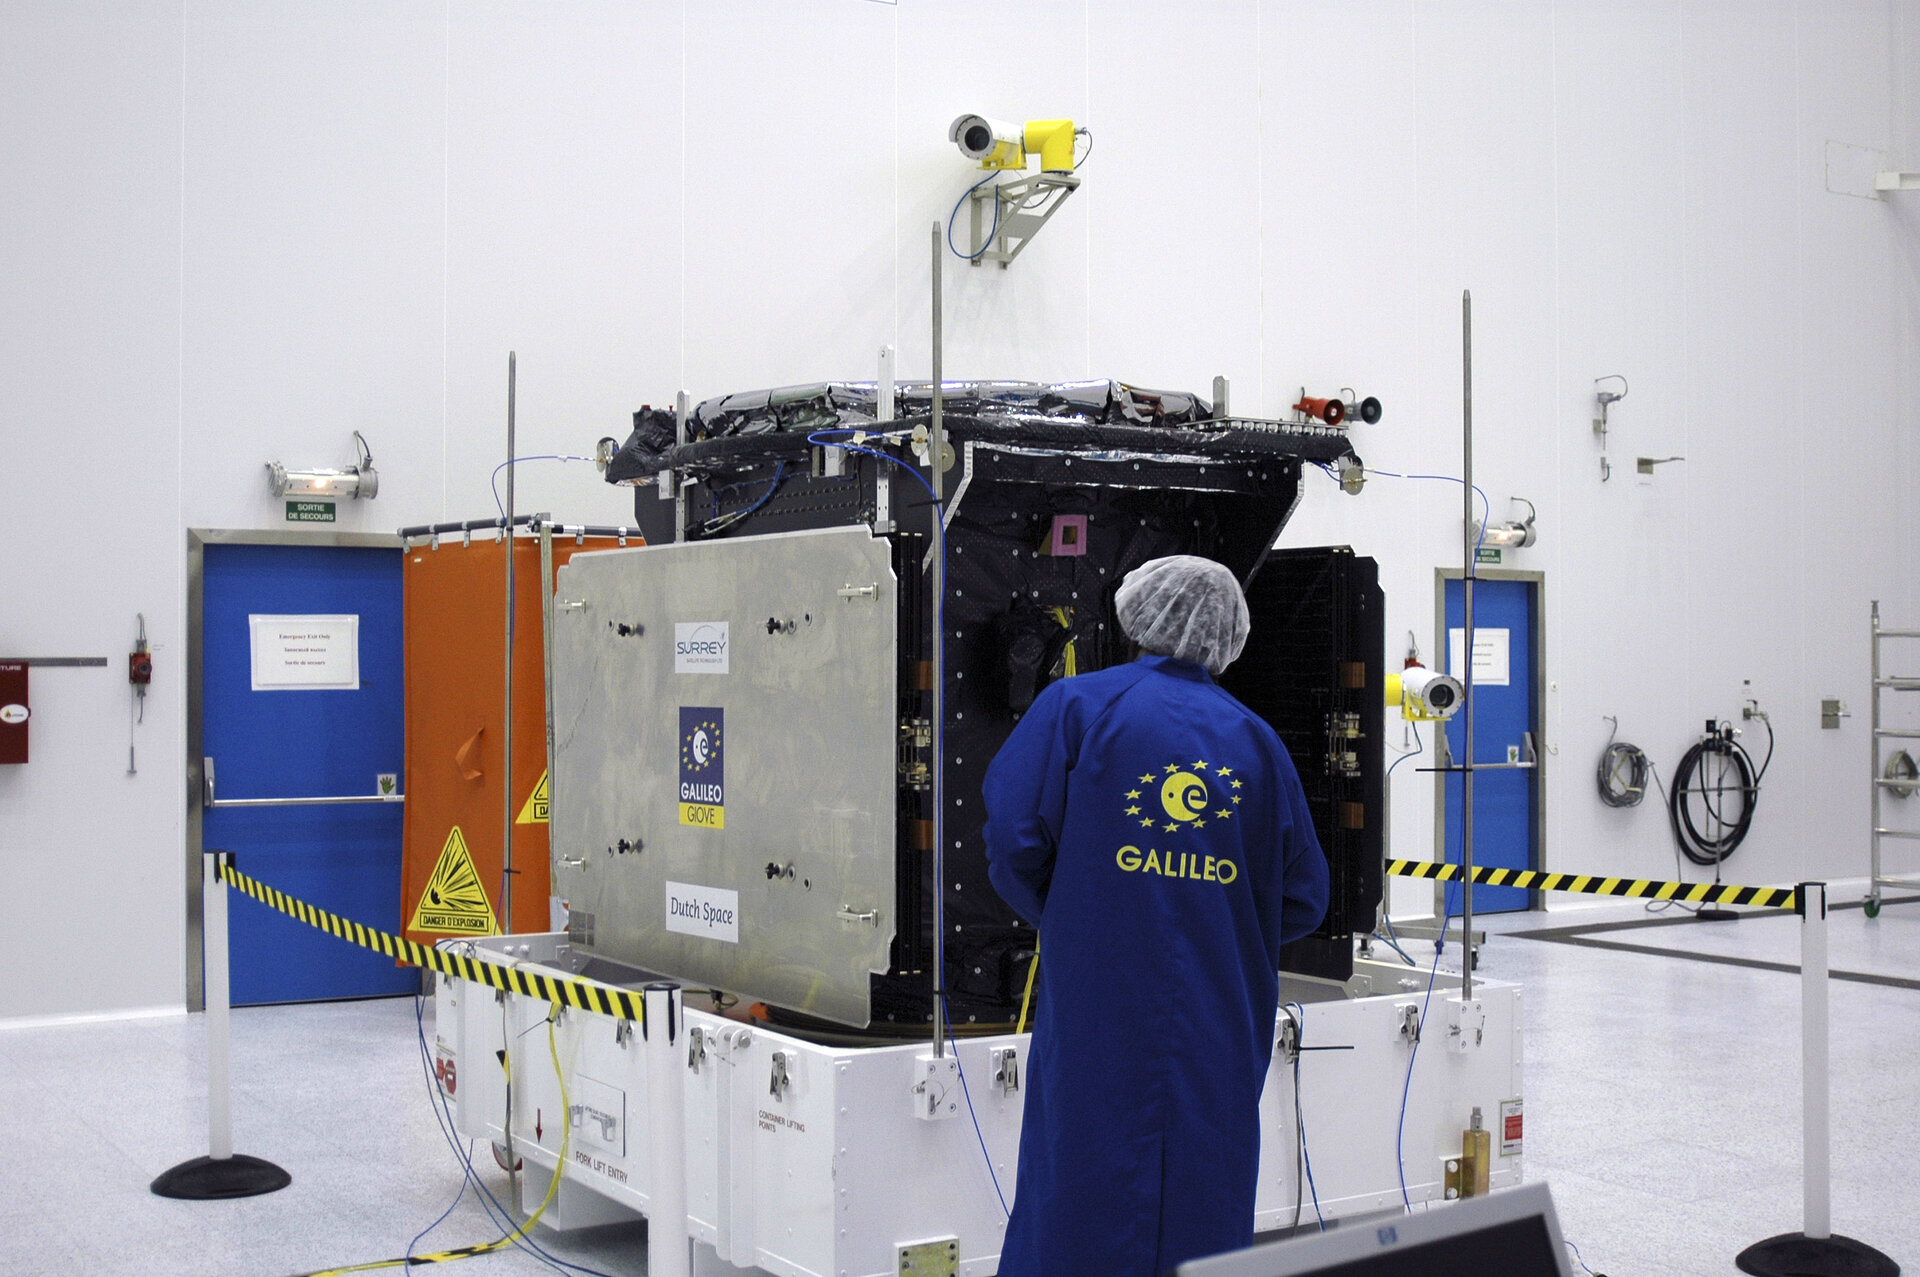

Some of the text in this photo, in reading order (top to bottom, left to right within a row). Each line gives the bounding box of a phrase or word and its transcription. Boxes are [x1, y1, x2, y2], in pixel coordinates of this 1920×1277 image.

[288, 512, 334, 521] DE SECOURS
[297, 503, 325, 512] SORTIE
[676, 641, 727, 655] SURREY
[680, 782, 722, 803] GALILEO
[687, 805, 715, 824] GIOVE
[1116, 845, 1238, 885] GALILEO
[423, 915, 446, 926] DANGER
[671, 896, 733, 928] Dutch Space
[758, 1109, 805, 1133] CONTAINER LIFTING
[758, 1119, 777, 1133] POINTS
[575, 1150, 628, 1184] FORK LIFT ENTRY
